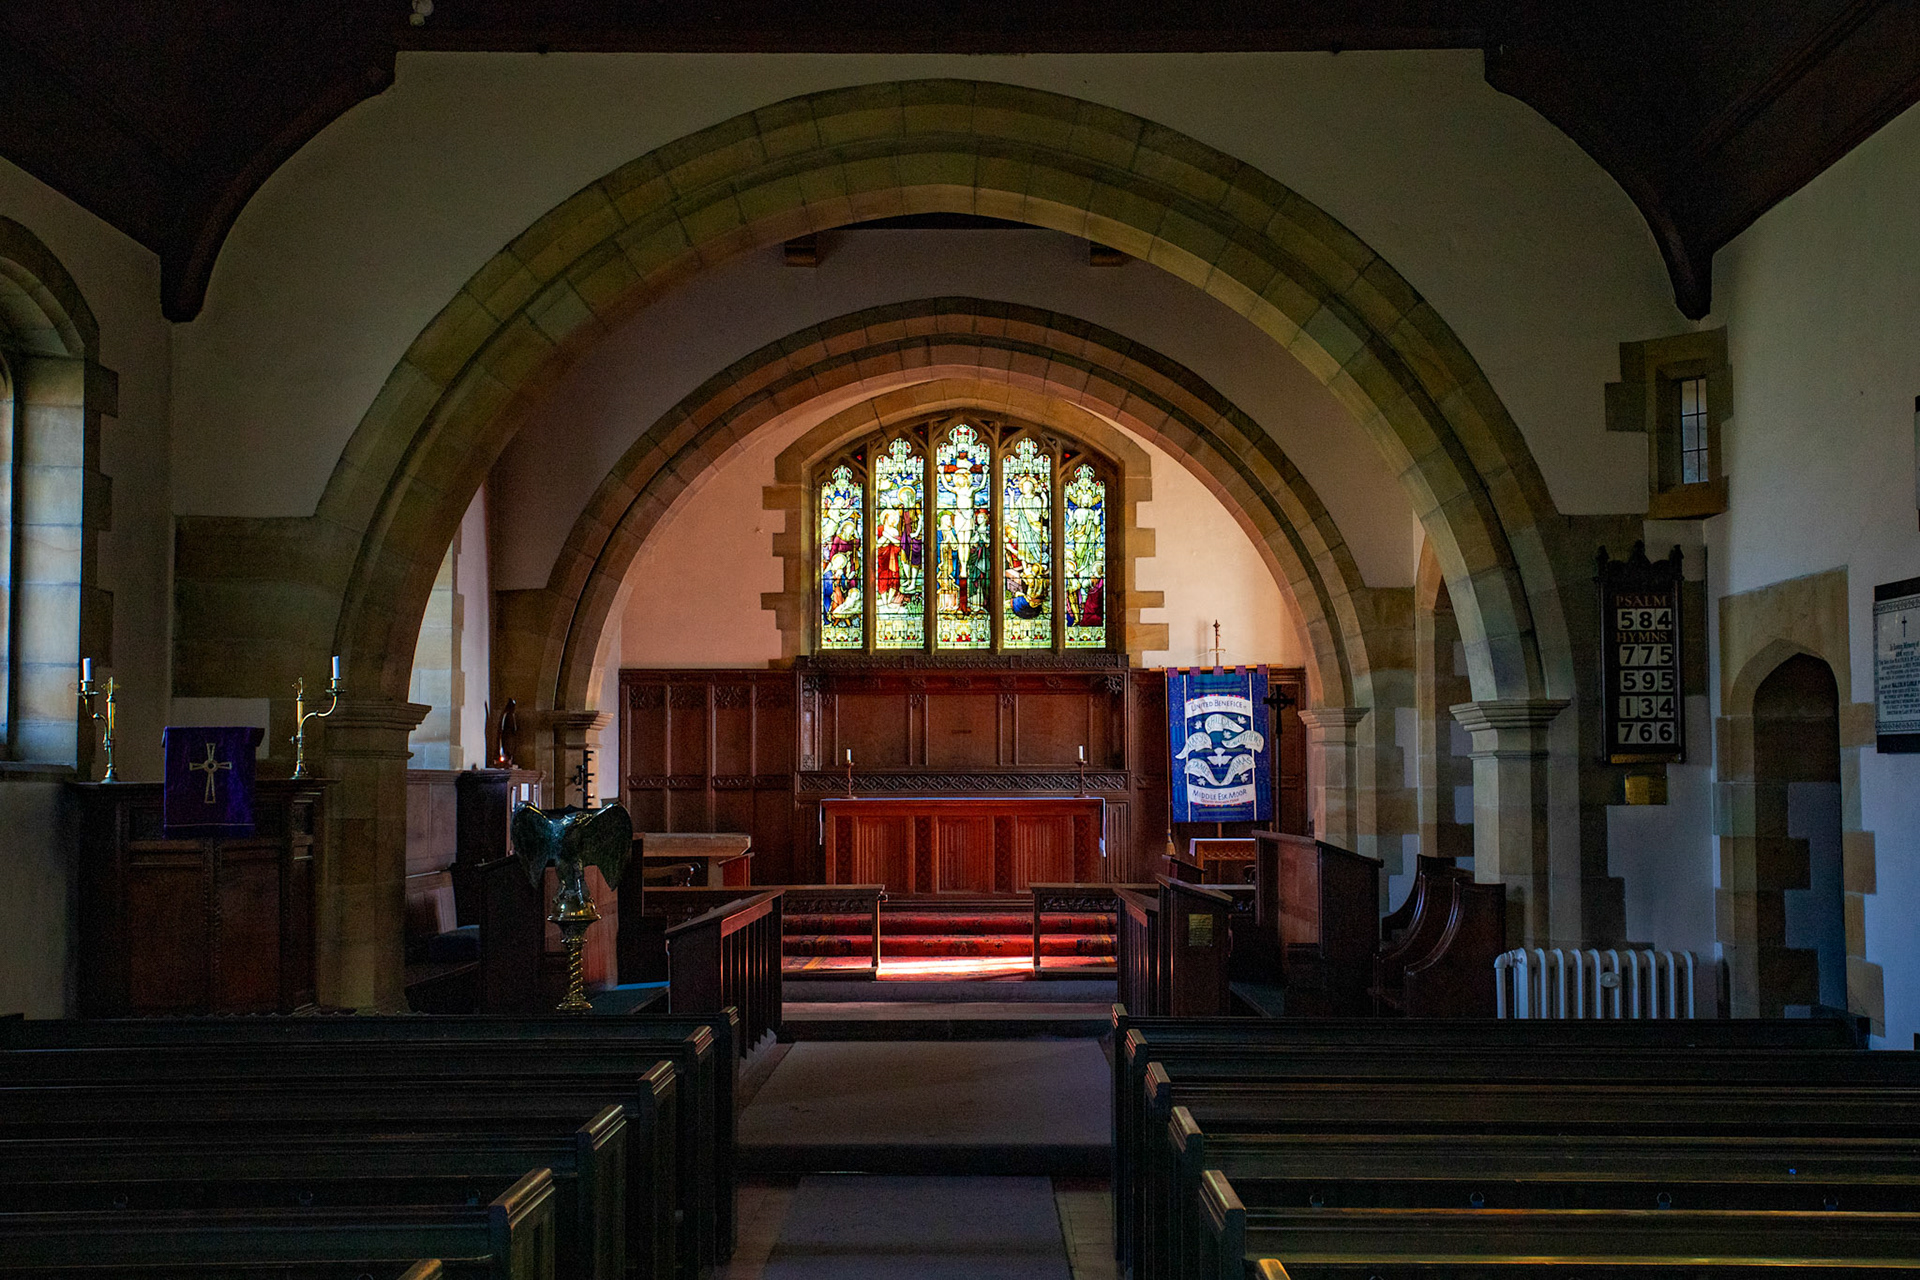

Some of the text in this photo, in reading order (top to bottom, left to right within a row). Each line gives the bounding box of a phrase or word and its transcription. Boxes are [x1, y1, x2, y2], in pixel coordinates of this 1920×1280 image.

[1615, 595, 1667, 608] PSALM
[1620, 611, 1672, 630] 584
[1615, 631, 1668, 643] HYMNS
[1622, 646, 1673, 665] 775
[1623, 672, 1673, 690] 595
[1214, 699, 1243, 708] BENEFICE
[1625, 698, 1674, 716] 134
[1620, 723, 1672, 742] 766
